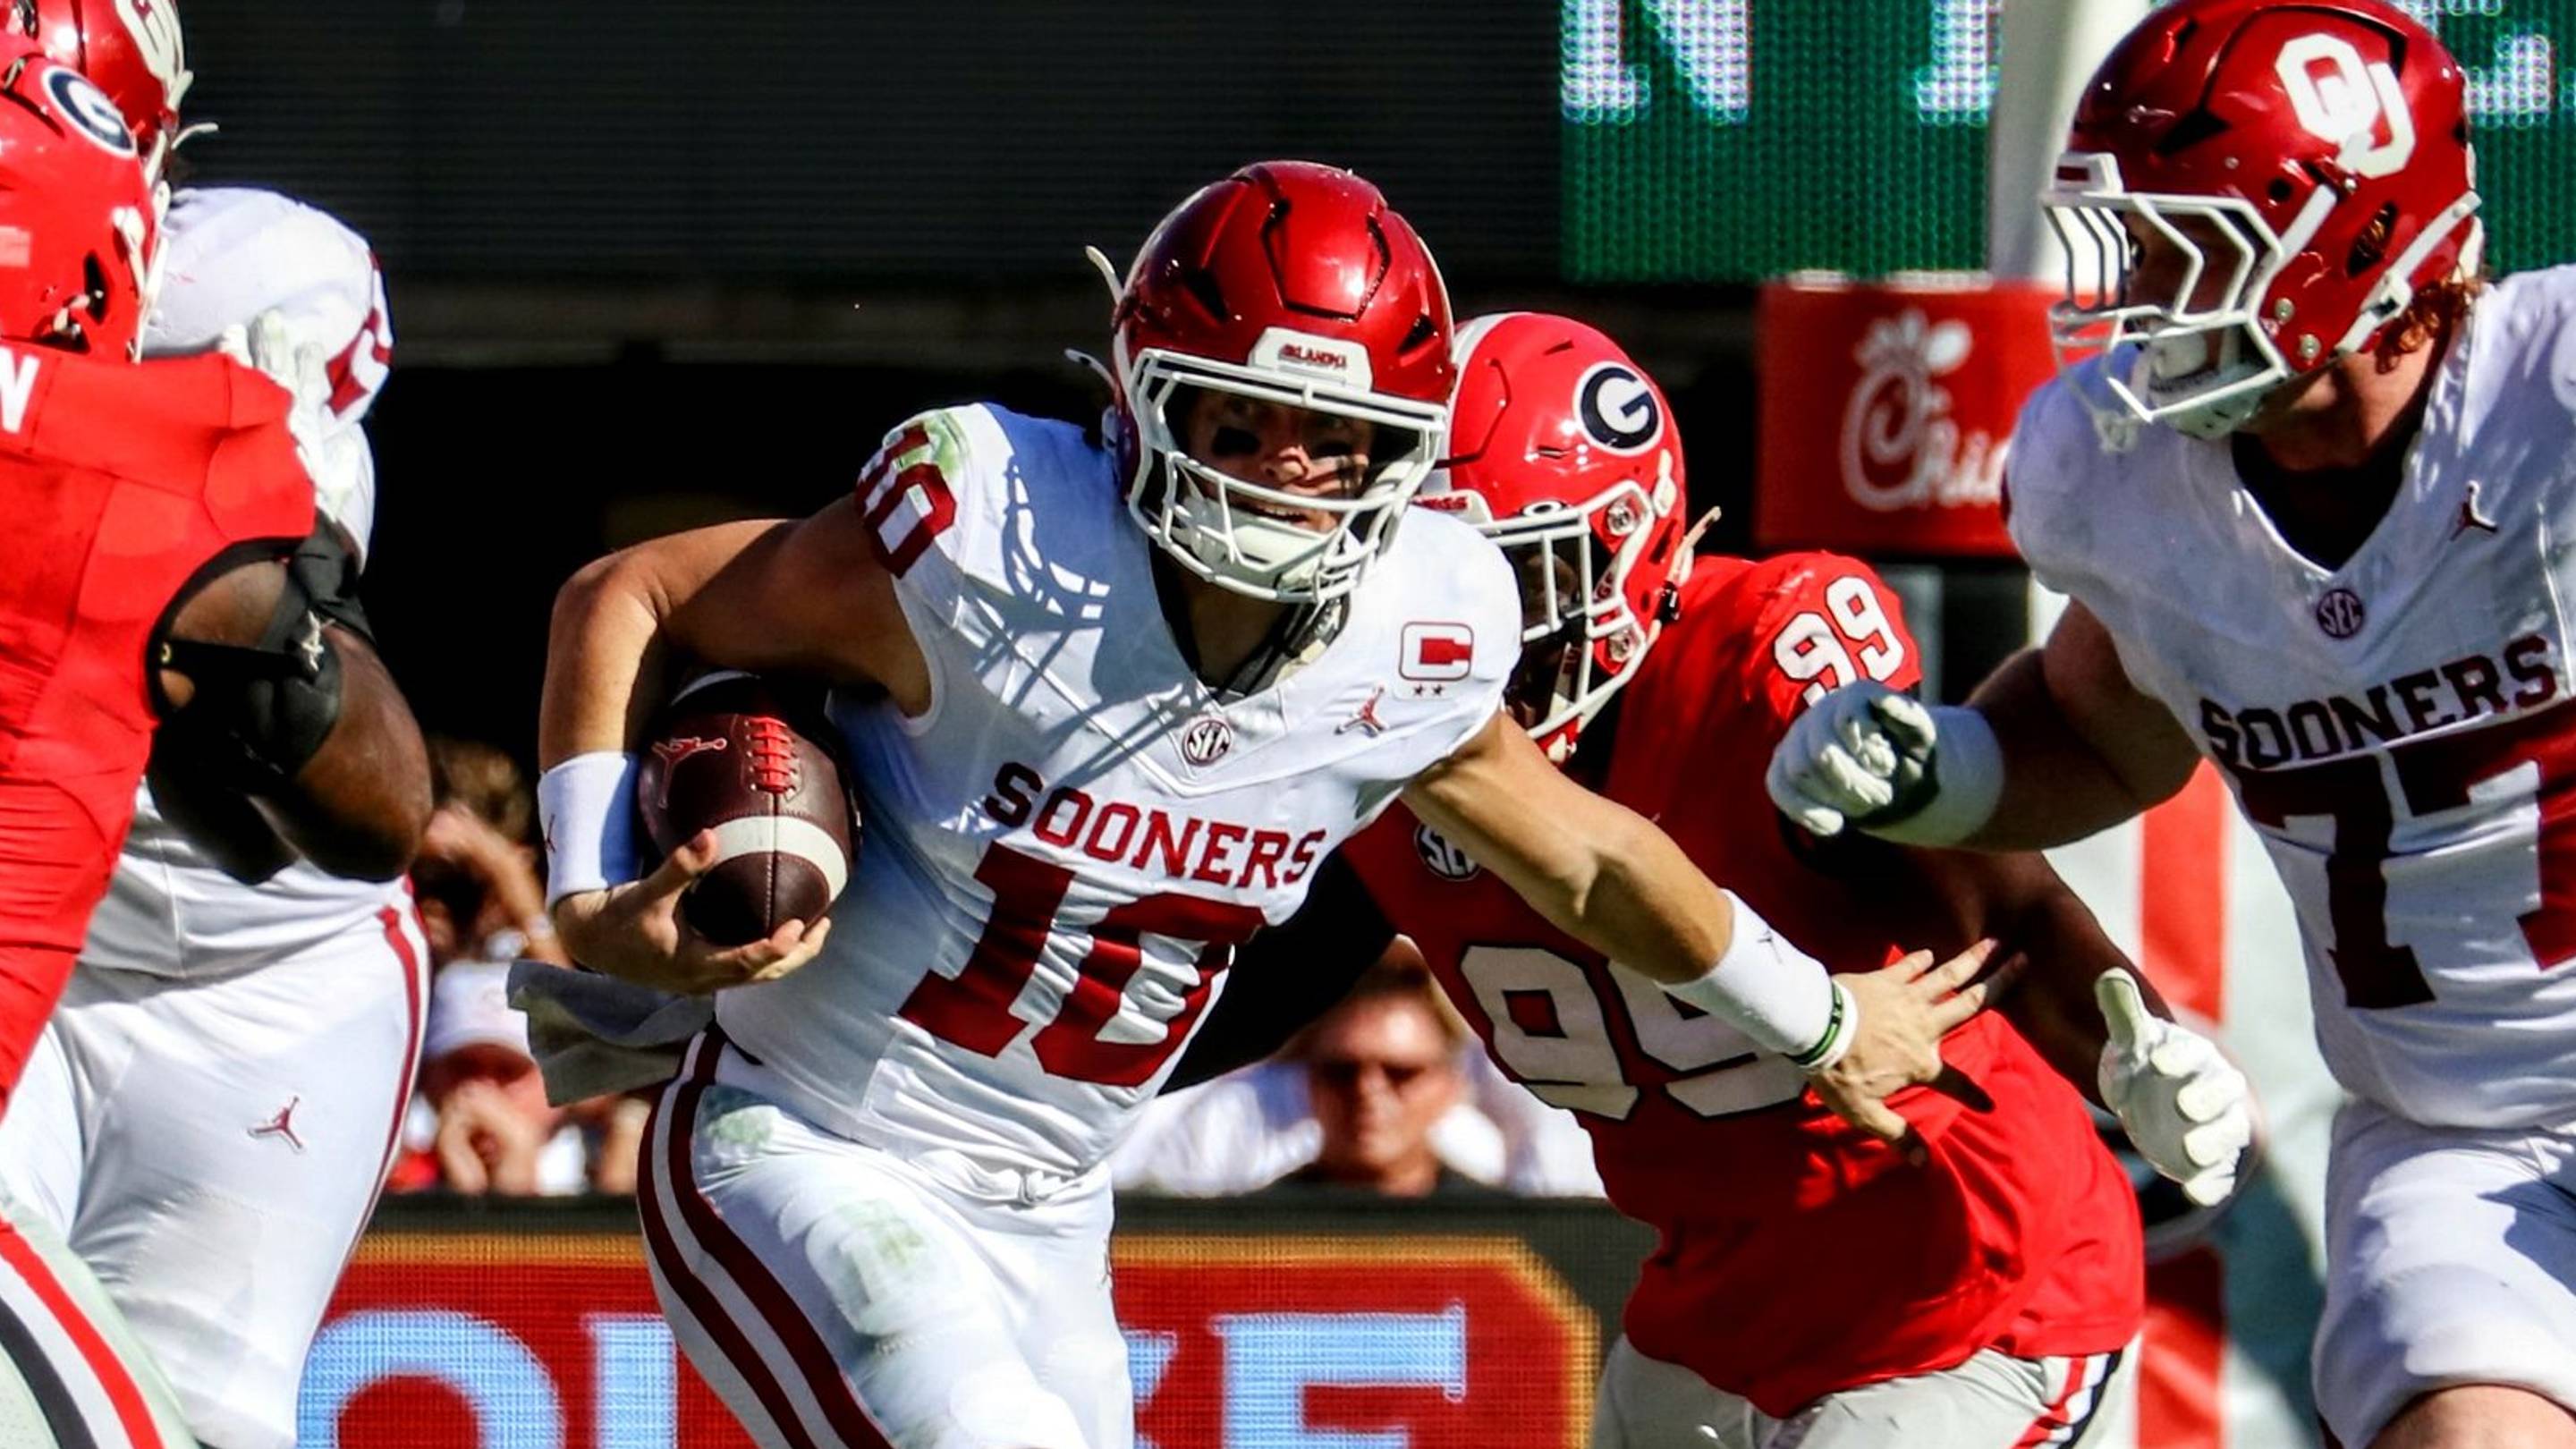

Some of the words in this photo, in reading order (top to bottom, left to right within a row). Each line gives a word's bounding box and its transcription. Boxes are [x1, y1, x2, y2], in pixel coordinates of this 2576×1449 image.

[1578, 364, 1661, 452] G
[854, 420, 957, 580] 10
[1774, 575, 1905, 707] 99
[2318, 589, 2363, 638] SEC
[1184, 720, 1231, 764] SEC
[2199, 634, 2558, 769] SOONERS
[985, 761, 1326, 889] SOONERS
[2233, 694, 2576, 1009] 77
[897, 842, 1267, 1089] 10
